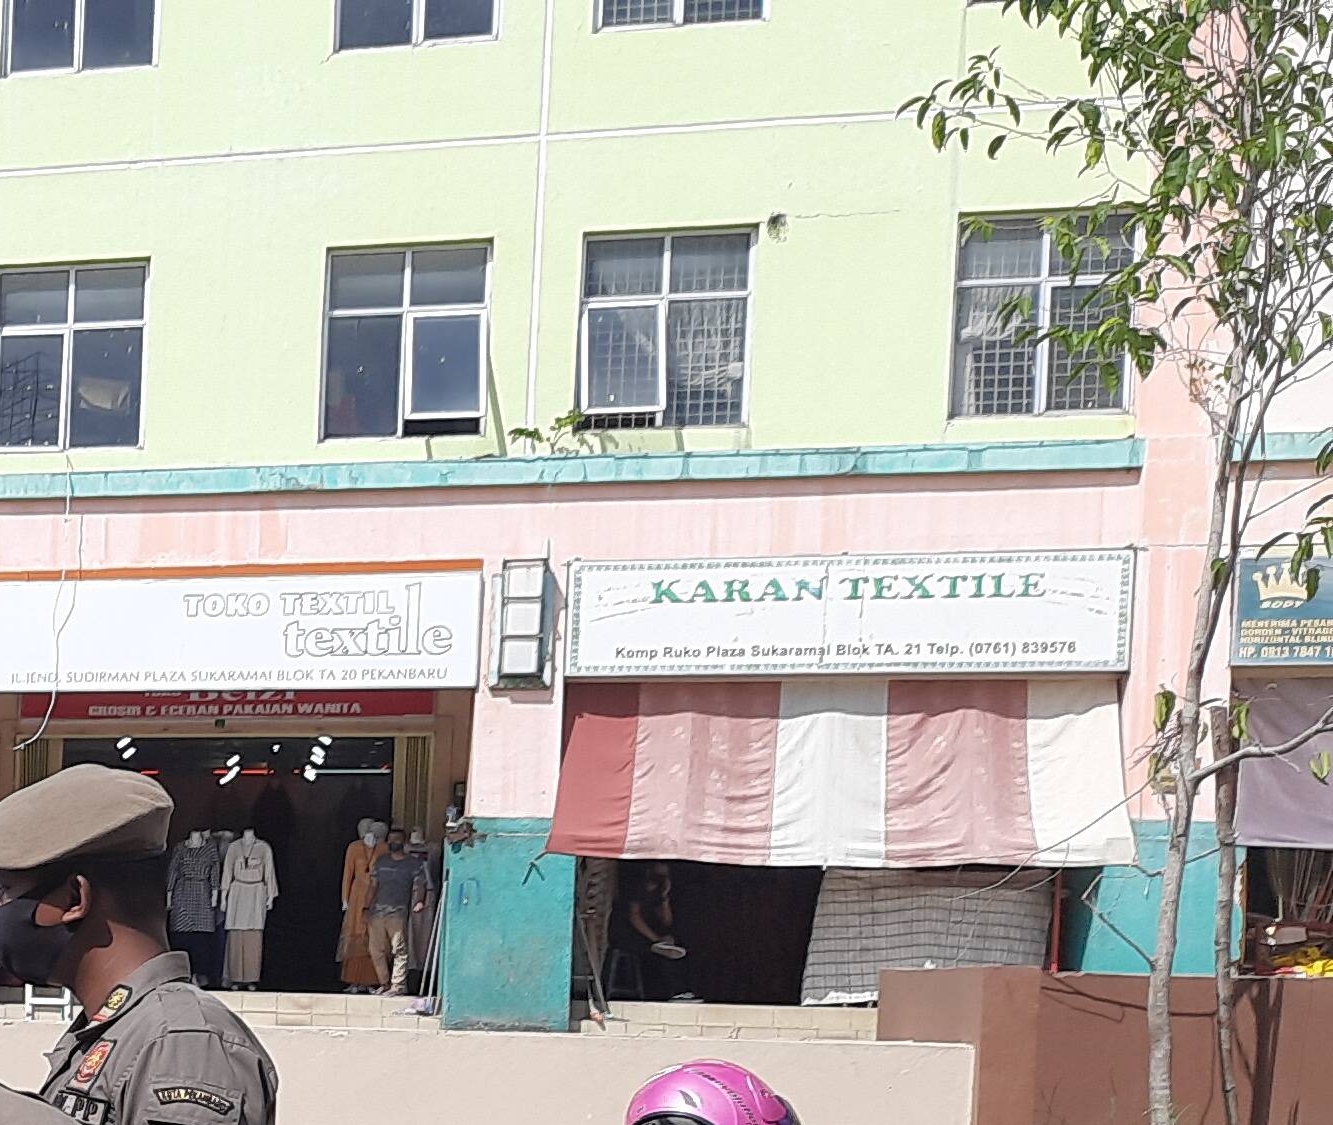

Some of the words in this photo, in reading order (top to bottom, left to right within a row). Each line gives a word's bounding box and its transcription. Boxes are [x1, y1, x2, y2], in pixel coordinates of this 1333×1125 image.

[648, 577, 827, 604] KARAN
[838, 573, 1047, 601] TEXTILE
[183, 592, 271, 617] TOKO
[280, 590, 395, 616] TEXTIL
[1259, 600, 1305, 609] BODY
[282, 581, 454, 658] textile
[614, 646, 658, 660] Komp
[662, 646, 701, 659] Ruko
[706, 645, 746, 658] Plaza
[836, 643, 871, 656] Blok
[904, 643, 921, 655] 21
[968, 641, 1017, 657] (0761)
[65, 670, 140, 684] SUDIRMAN
[144, 670, 186, 683] PLAZA
[191, 668, 273, 683] SUKARAMAI
[276, 668, 315, 681] BLOK
[319, 668, 337, 681] TA
[340, 668, 358, 681] 20
[361, 666, 449, 681] PEKANBARU
[222, 702, 294, 715] PAKAIAN
[296, 701, 362, 714] WANITA
